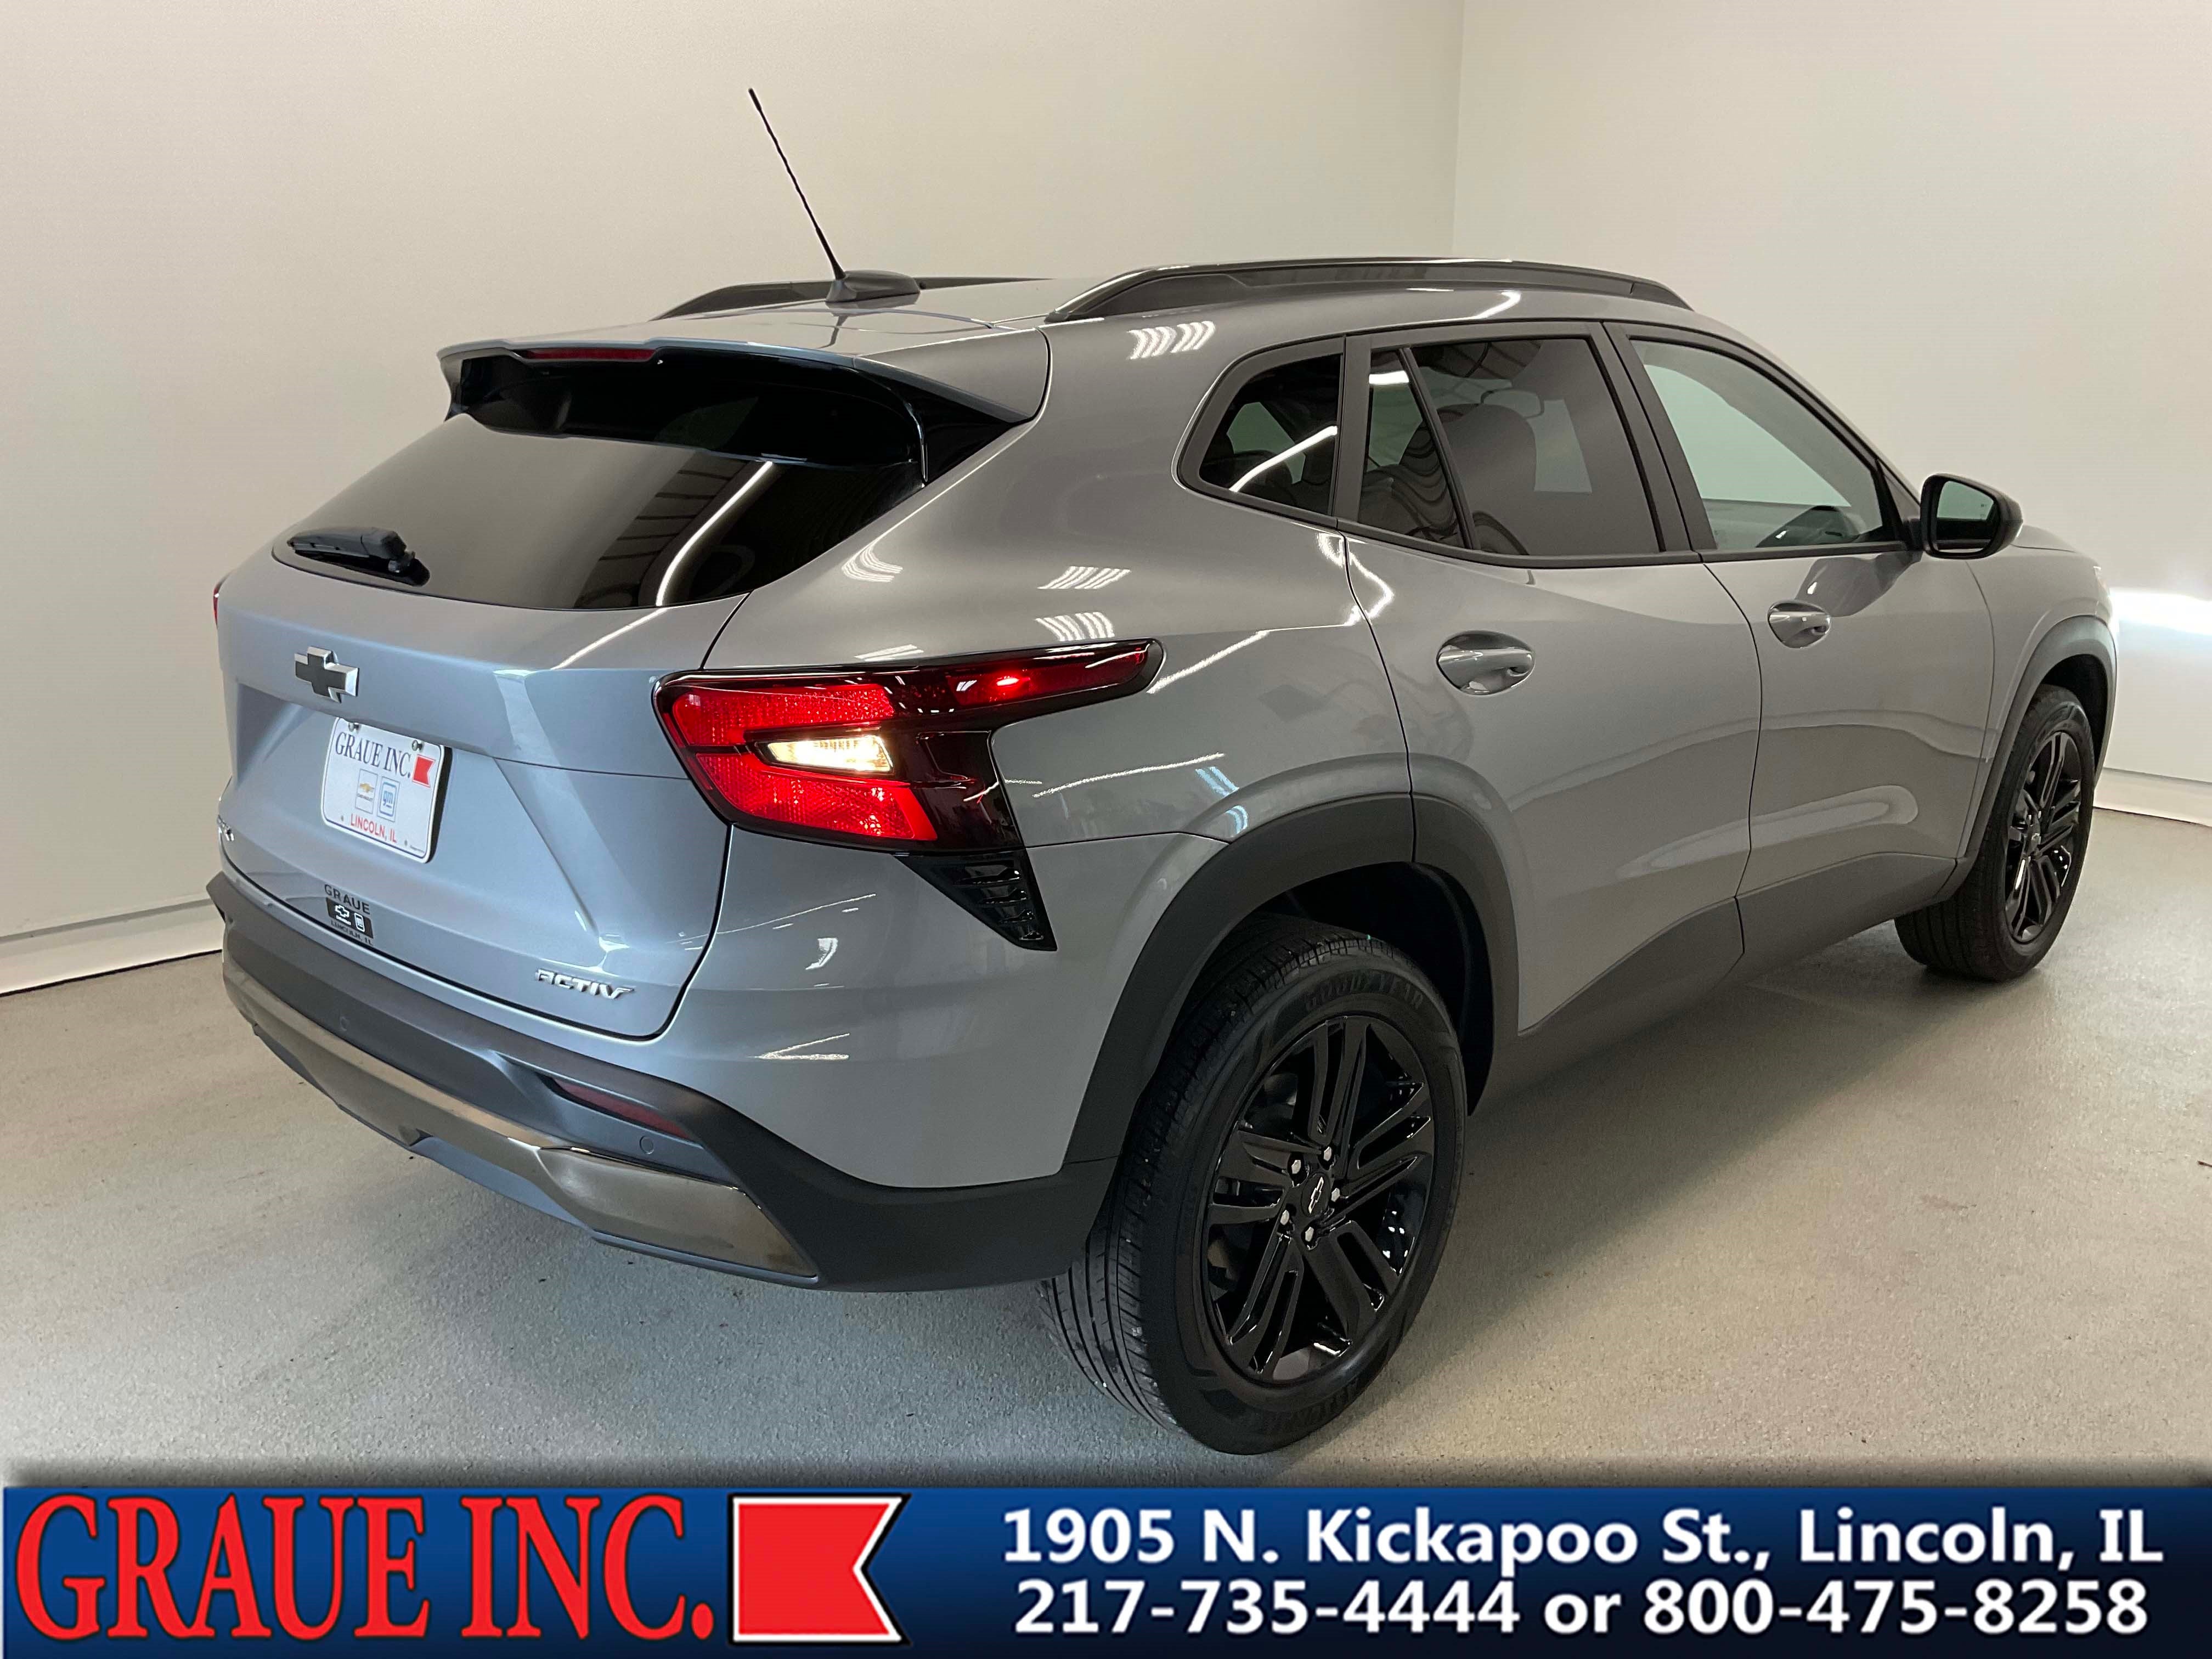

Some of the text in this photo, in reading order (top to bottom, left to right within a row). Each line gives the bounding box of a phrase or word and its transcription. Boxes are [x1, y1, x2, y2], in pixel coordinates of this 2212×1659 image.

[335, 732, 411, 778] GRAUE INC.
[351, 814, 397, 843] LINCOLN, IL
[324, 884, 370, 915] GRAUE
[535, 963, 635, 1000] ACTIV
